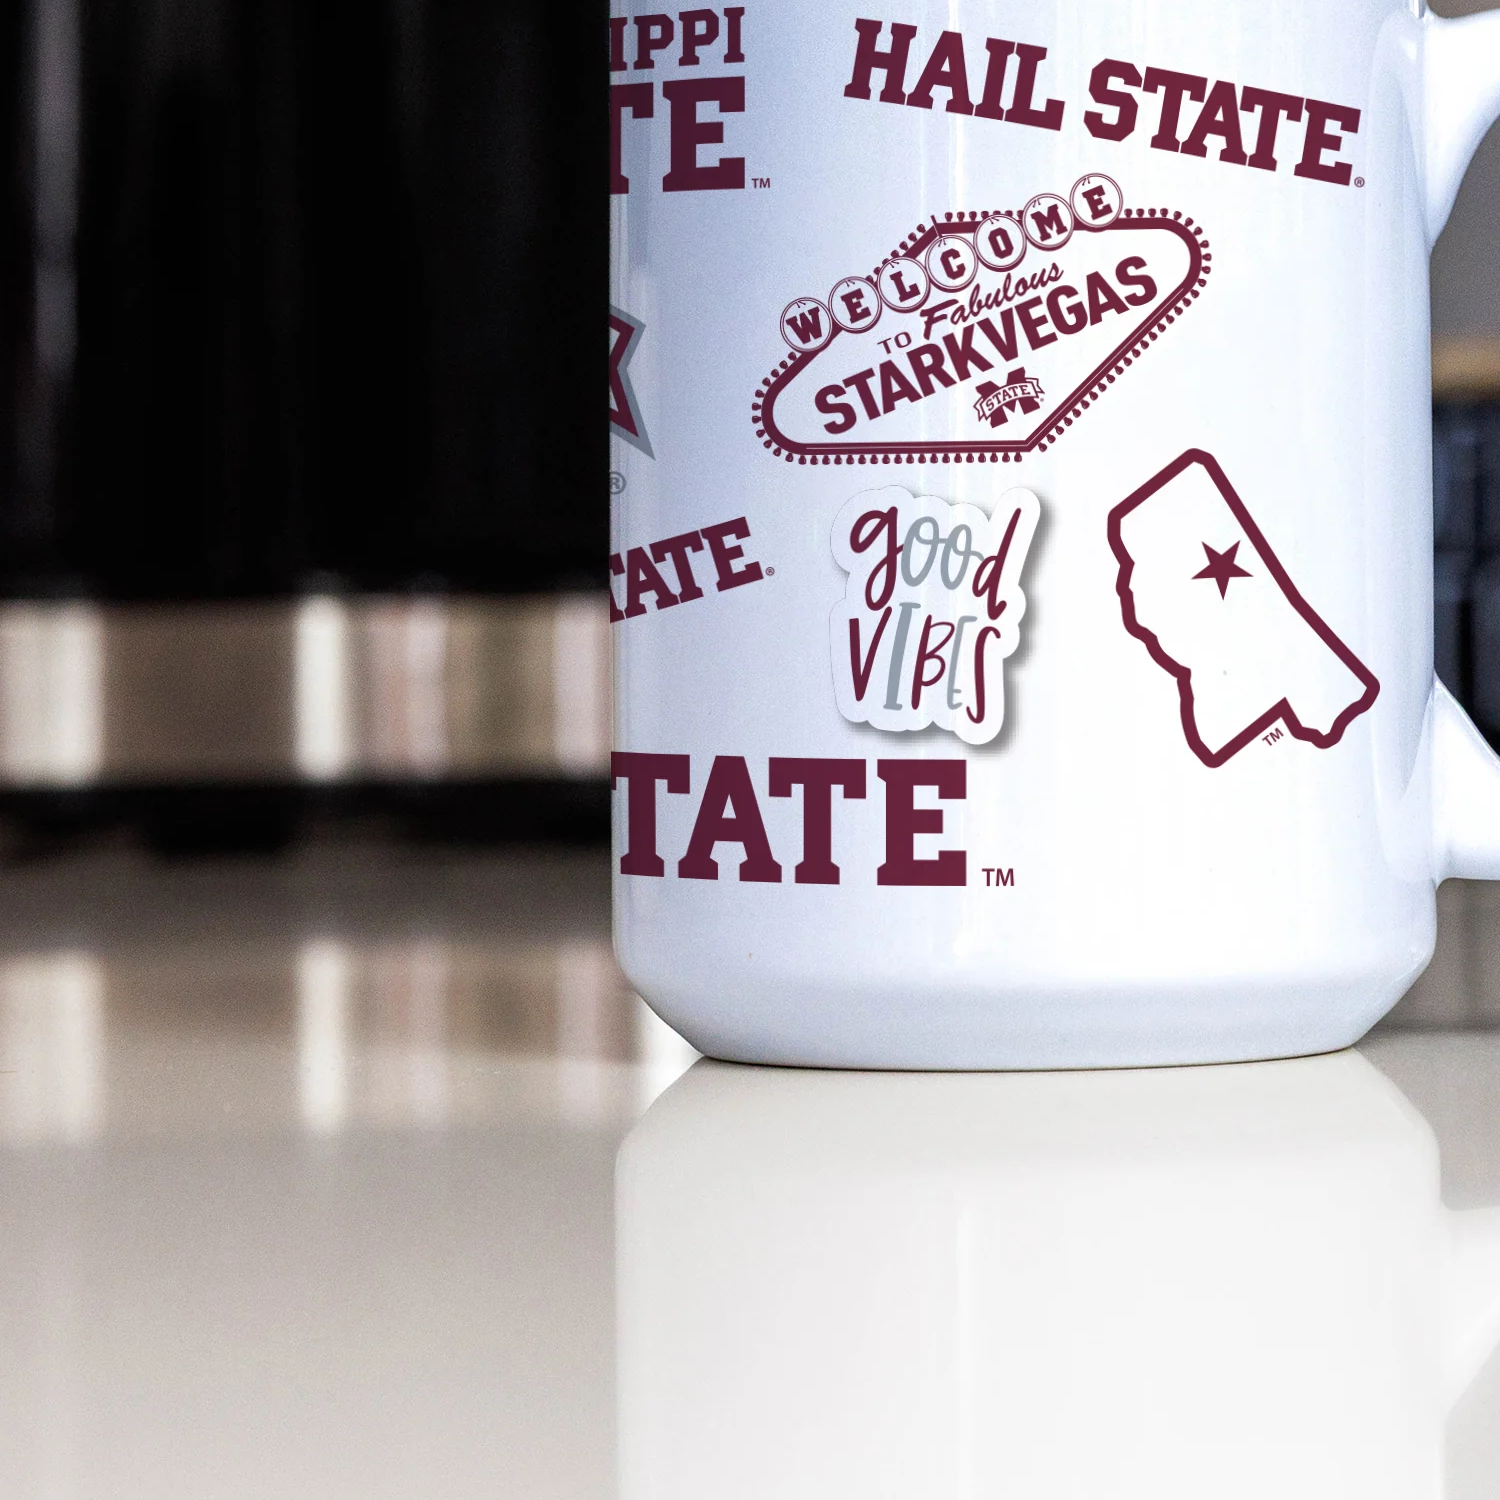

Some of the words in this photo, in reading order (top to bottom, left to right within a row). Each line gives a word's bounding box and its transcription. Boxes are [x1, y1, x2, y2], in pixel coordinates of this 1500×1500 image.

[610, 6, 745, 73] IPPI
[843, 17, 1066, 132] HAIL
[1082, 57, 1362, 187] STATE
[785, 184, 1114, 345] WELCOME
[877, 331, 912, 355] TO
[919, 262, 1065, 341] Fabulous
[813, 255, 1159, 435] STARKVEGAS
[985, 384, 1031, 412] STATE
[849, 506, 1022, 621] good
[849, 602, 1002, 724] VIBES
[611, 751, 967, 887] TATE
[981, 867, 1016, 887] TM
